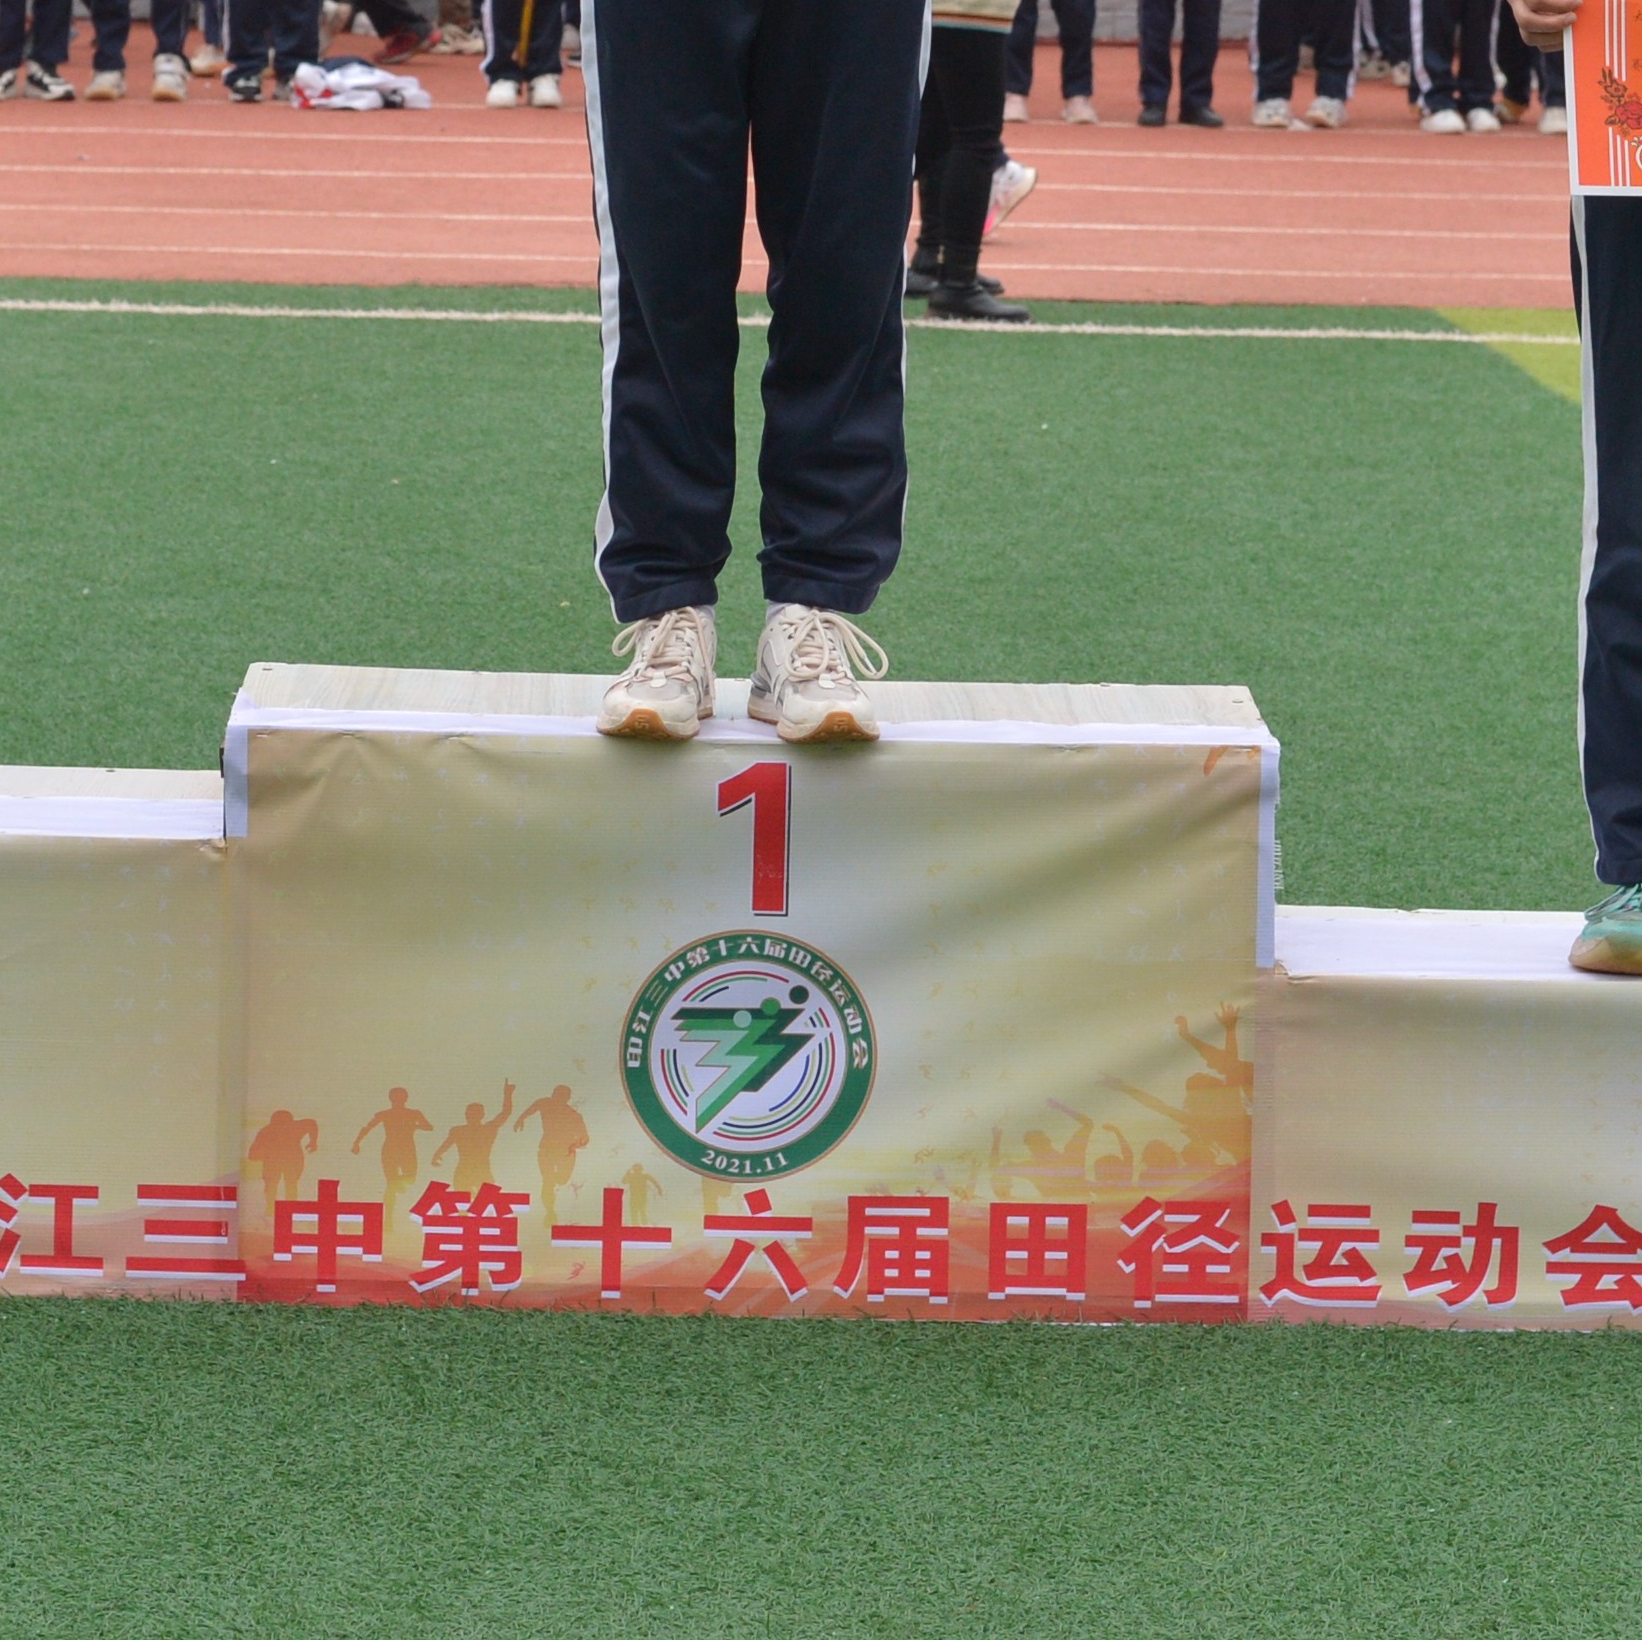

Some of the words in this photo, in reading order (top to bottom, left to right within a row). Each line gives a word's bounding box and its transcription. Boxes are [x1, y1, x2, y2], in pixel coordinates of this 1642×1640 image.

[716, 760, 792, 917] 1
[625, 935, 870, 1070] 印江三中第十六届田径运动会
[700, 1148, 789, 1175] 2021.11
